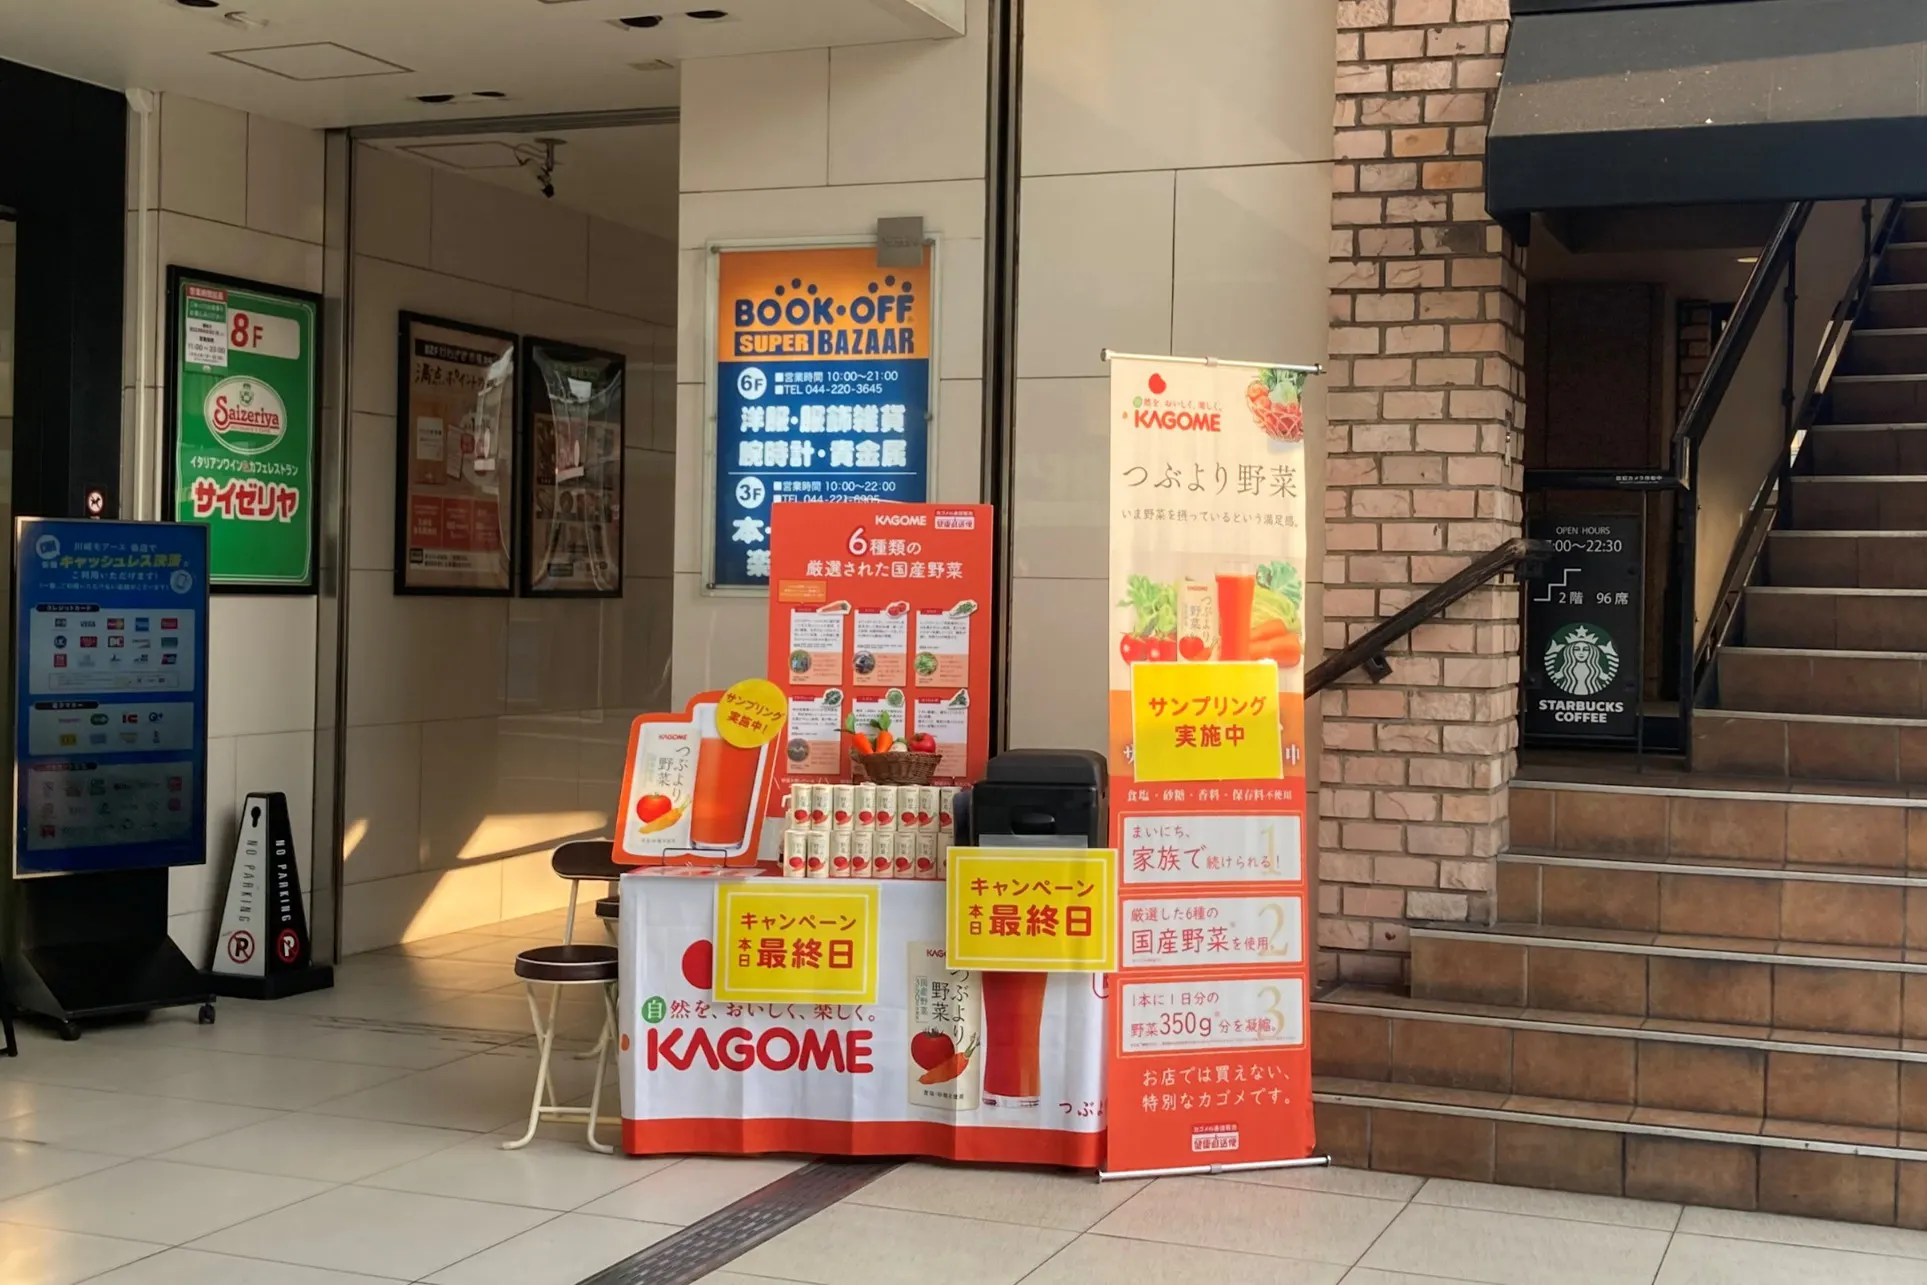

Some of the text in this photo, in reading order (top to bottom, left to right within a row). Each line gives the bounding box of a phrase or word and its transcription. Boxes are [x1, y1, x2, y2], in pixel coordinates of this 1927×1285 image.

[231, 313, 263, 348] 8F
[739, 328, 914, 355] SUPER BAZAAR
[740, 375, 764, 392] 6F
[785, 384, 883, 395] TEL 044-220-3645
[213, 396, 280, 429] Saizeriya
[1134, 409, 1221, 432] KAGOME
[739, 484, 762, 501] 3F
[1123, 461, 1297, 499] つぶより野菜
[193, 479, 298, 521] サイゼリヤ
[875, 515, 927, 526] KAGOME
[1555, 527, 1610, 535] OPEN HOURS
[849, 528, 922, 557] 6種類の
[1549, 539, 1622, 552] :00～22:30
[806, 560, 964, 579] 厳選された国産野菜
[727, 693, 785, 722] サンプリング
[1149, 696, 1267, 717] サンプリング
[1538, 700, 1624, 713] STARBUCKS
[1555, 712, 1607, 723] COFFEE
[1175, 723, 1246, 748] 実施中
[658, 757, 674, 787] 野菜
[672, 746, 691, 803] つぶより
[1132, 824, 1191, 839] まいにち、
[238, 840, 258, 922] NO PARKING
[275, 839, 291, 922] NO PARKING
[971, 878, 1094, 897] キャンペーン
[741, 912, 857, 931] キャンペーン
[969, 905, 983, 935] 本日
[989, 905, 1092, 937] 最終日
[1131, 907, 1219, 922] 厳選した6種の
[738, 938, 752, 968] 本日
[756, 937, 854, 969] 最終日
[927, 949, 947, 958] KAG
[931, 981, 950, 1022] 野菜
[950, 970, 970, 1046] つぶより
[647, 1027, 874, 1074] KAGOME
[1142, 1064, 1291, 1087] お店では買えない、
[1142, 1087, 1291, 1112] 特別なカゴメです。
